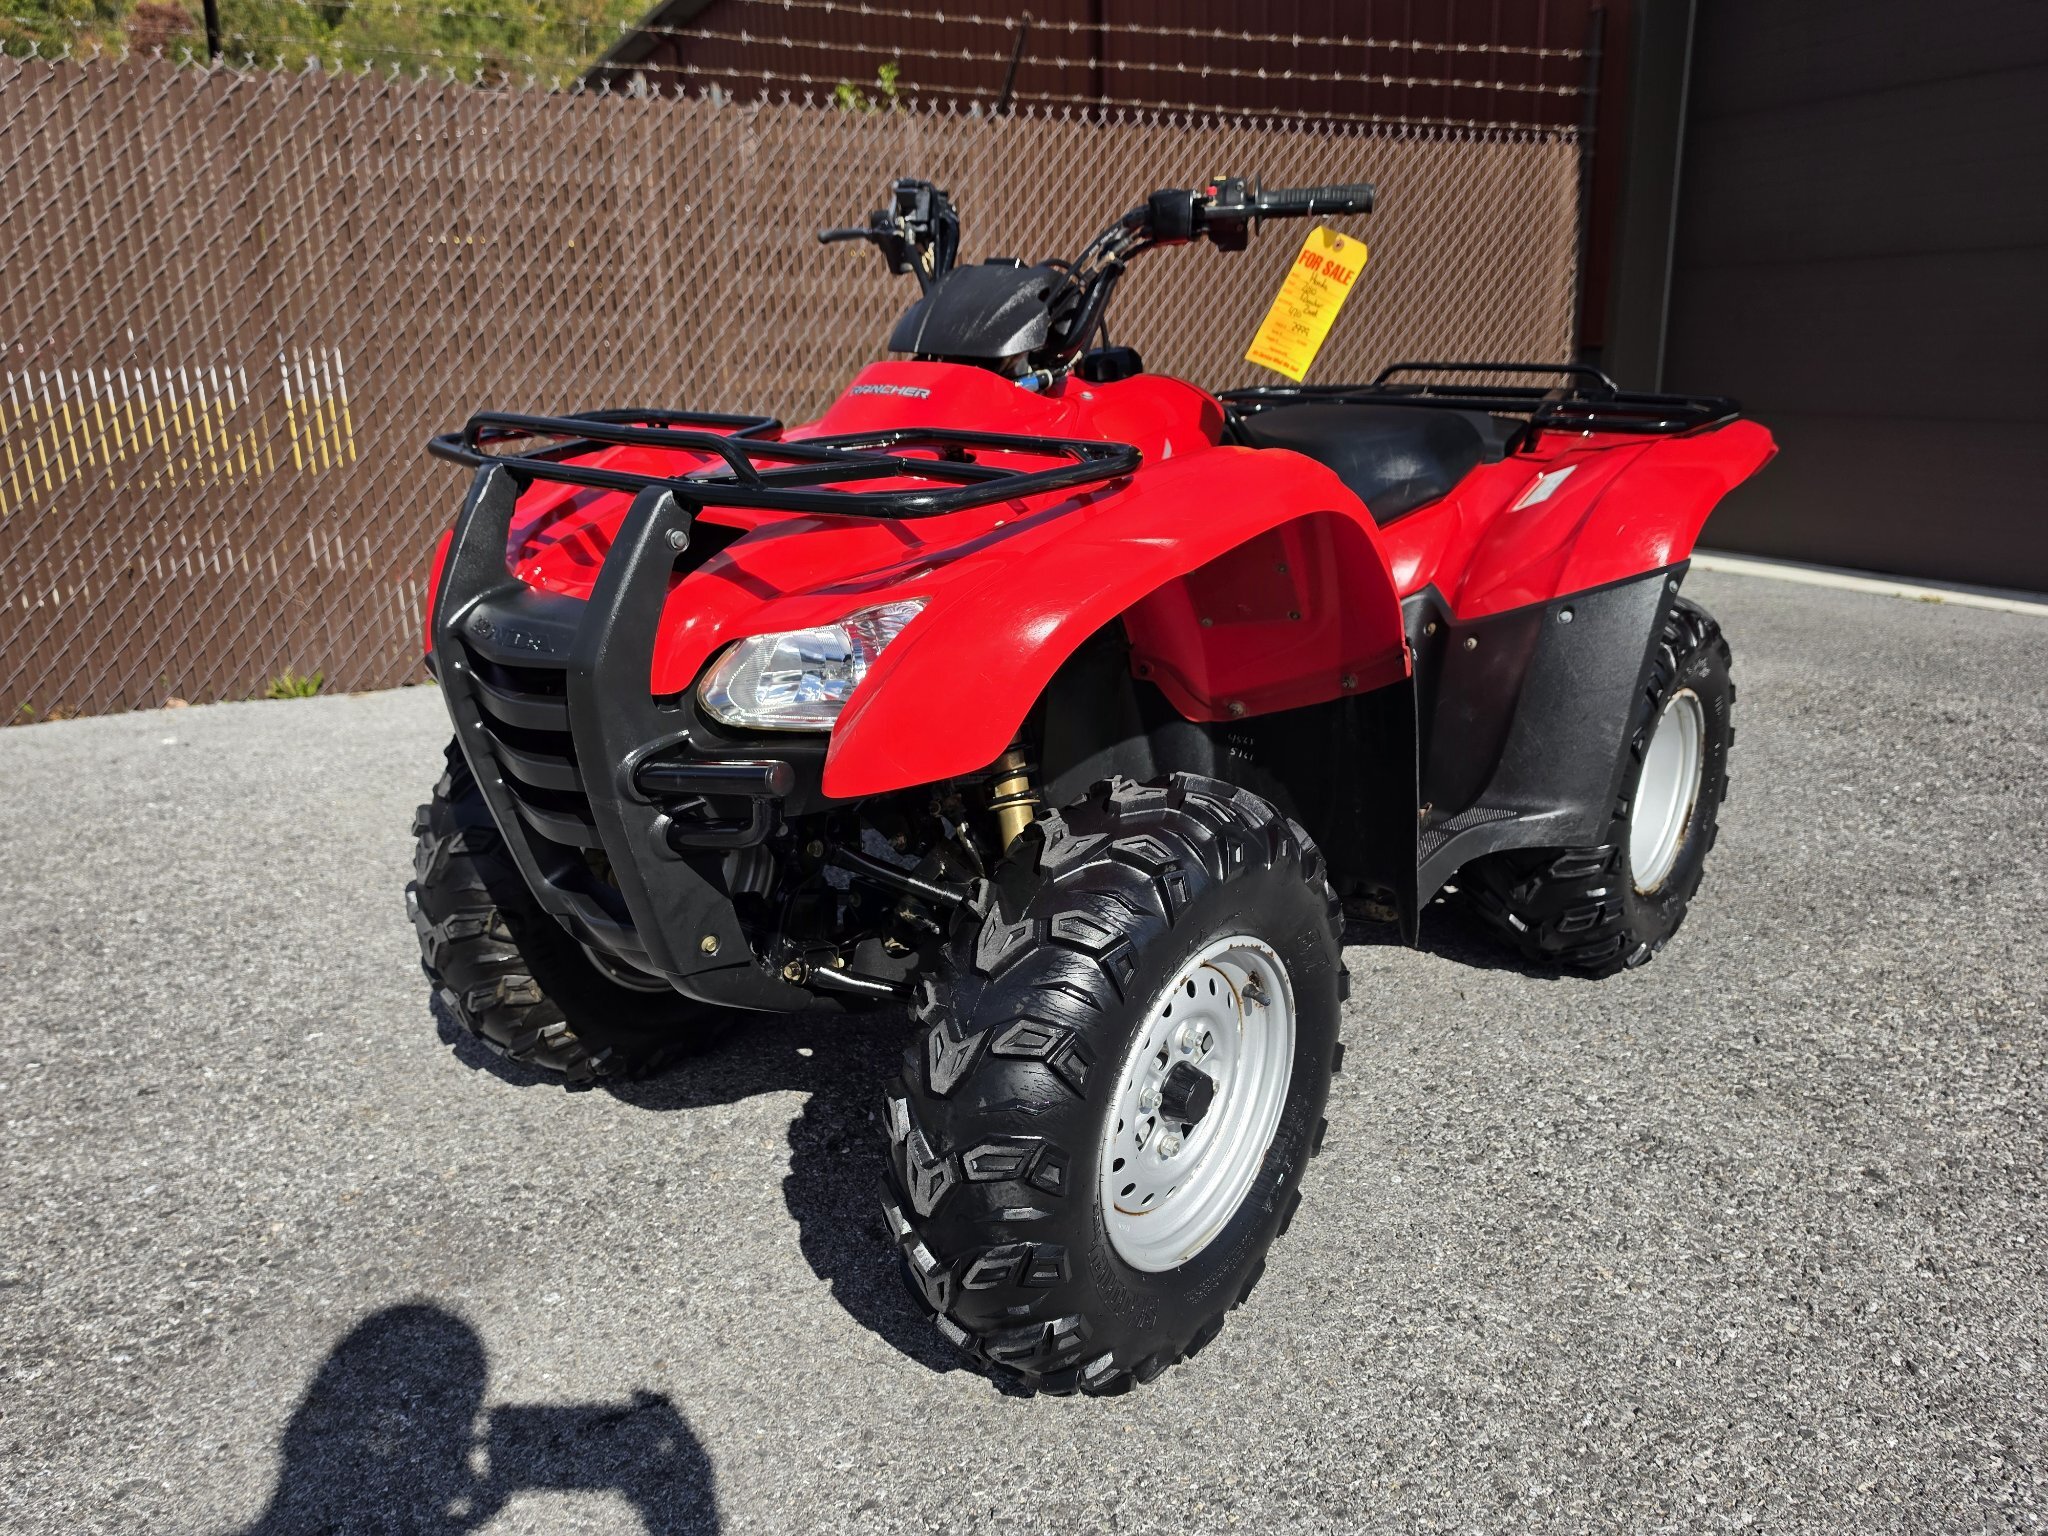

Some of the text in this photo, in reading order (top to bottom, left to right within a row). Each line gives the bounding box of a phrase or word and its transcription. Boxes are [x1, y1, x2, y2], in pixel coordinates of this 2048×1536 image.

[1298, 249, 1355, 286] FOR SALE
[849, 384, 931, 399] RANCHER
